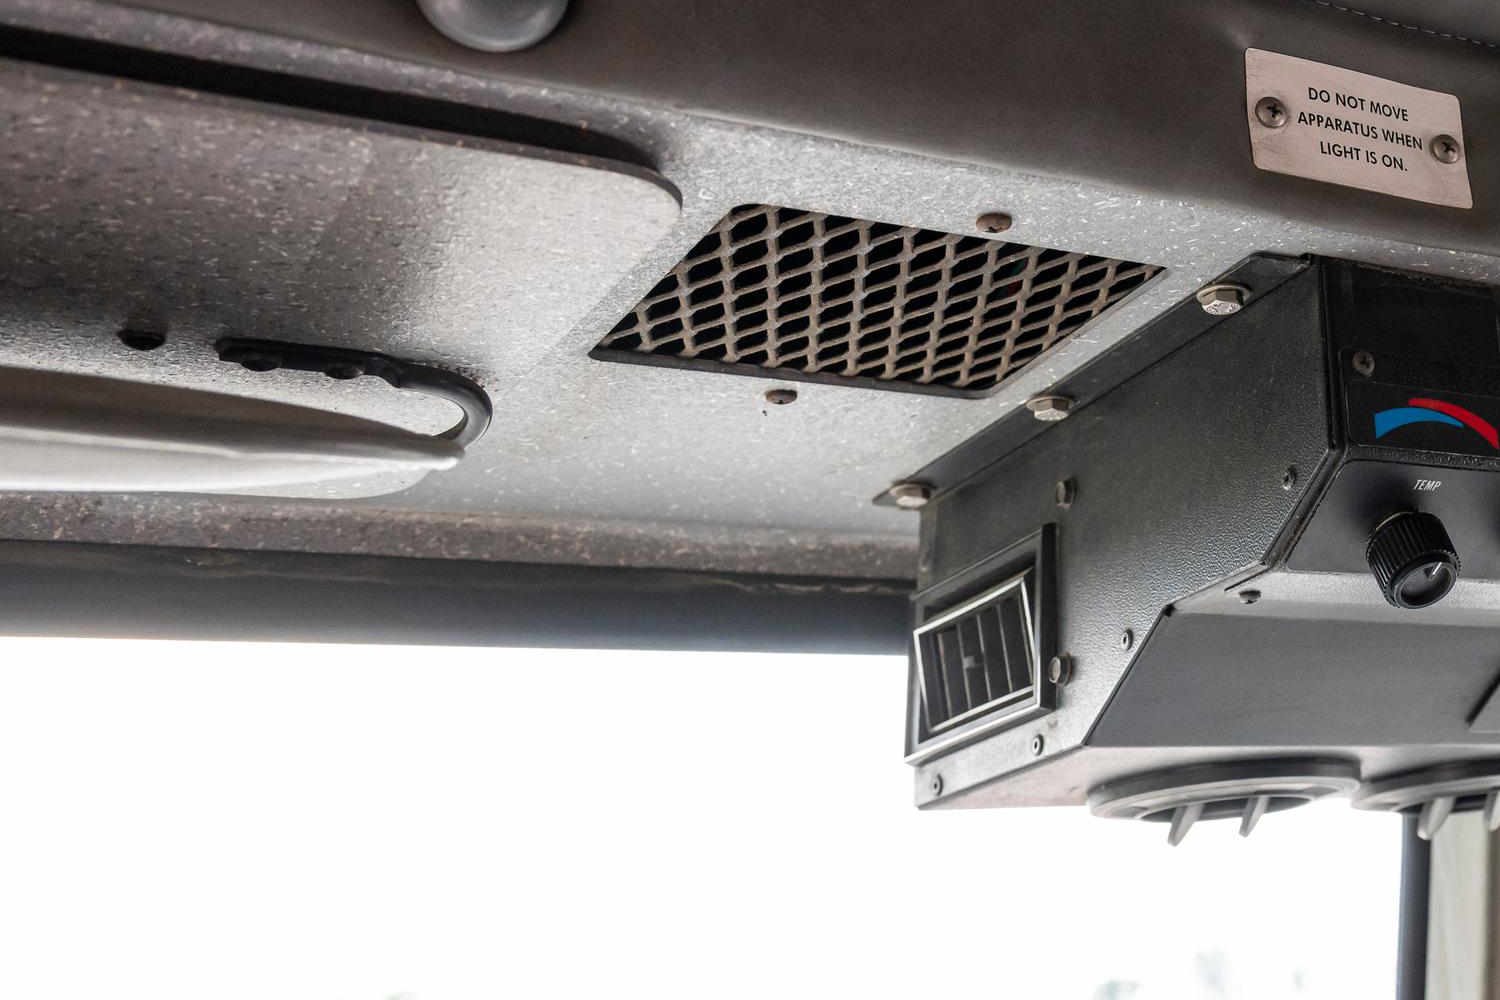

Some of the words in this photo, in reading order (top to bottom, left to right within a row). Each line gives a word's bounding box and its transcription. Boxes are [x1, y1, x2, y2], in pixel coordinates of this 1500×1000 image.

[1308, 87, 1330, 103] DO
[1335, 92, 1366, 111] NOT
[1370, 101, 1409, 122] MOVE
[1297, 111, 1378, 139] APPARATUS
[1381, 128, 1423, 150] WHEN
[1320, 141, 1361, 160] LIGHT
[1365, 150, 1378, 165] IS
[1381, 154, 1408, 171] ON.
[1413, 479, 1442, 491] TEMP
